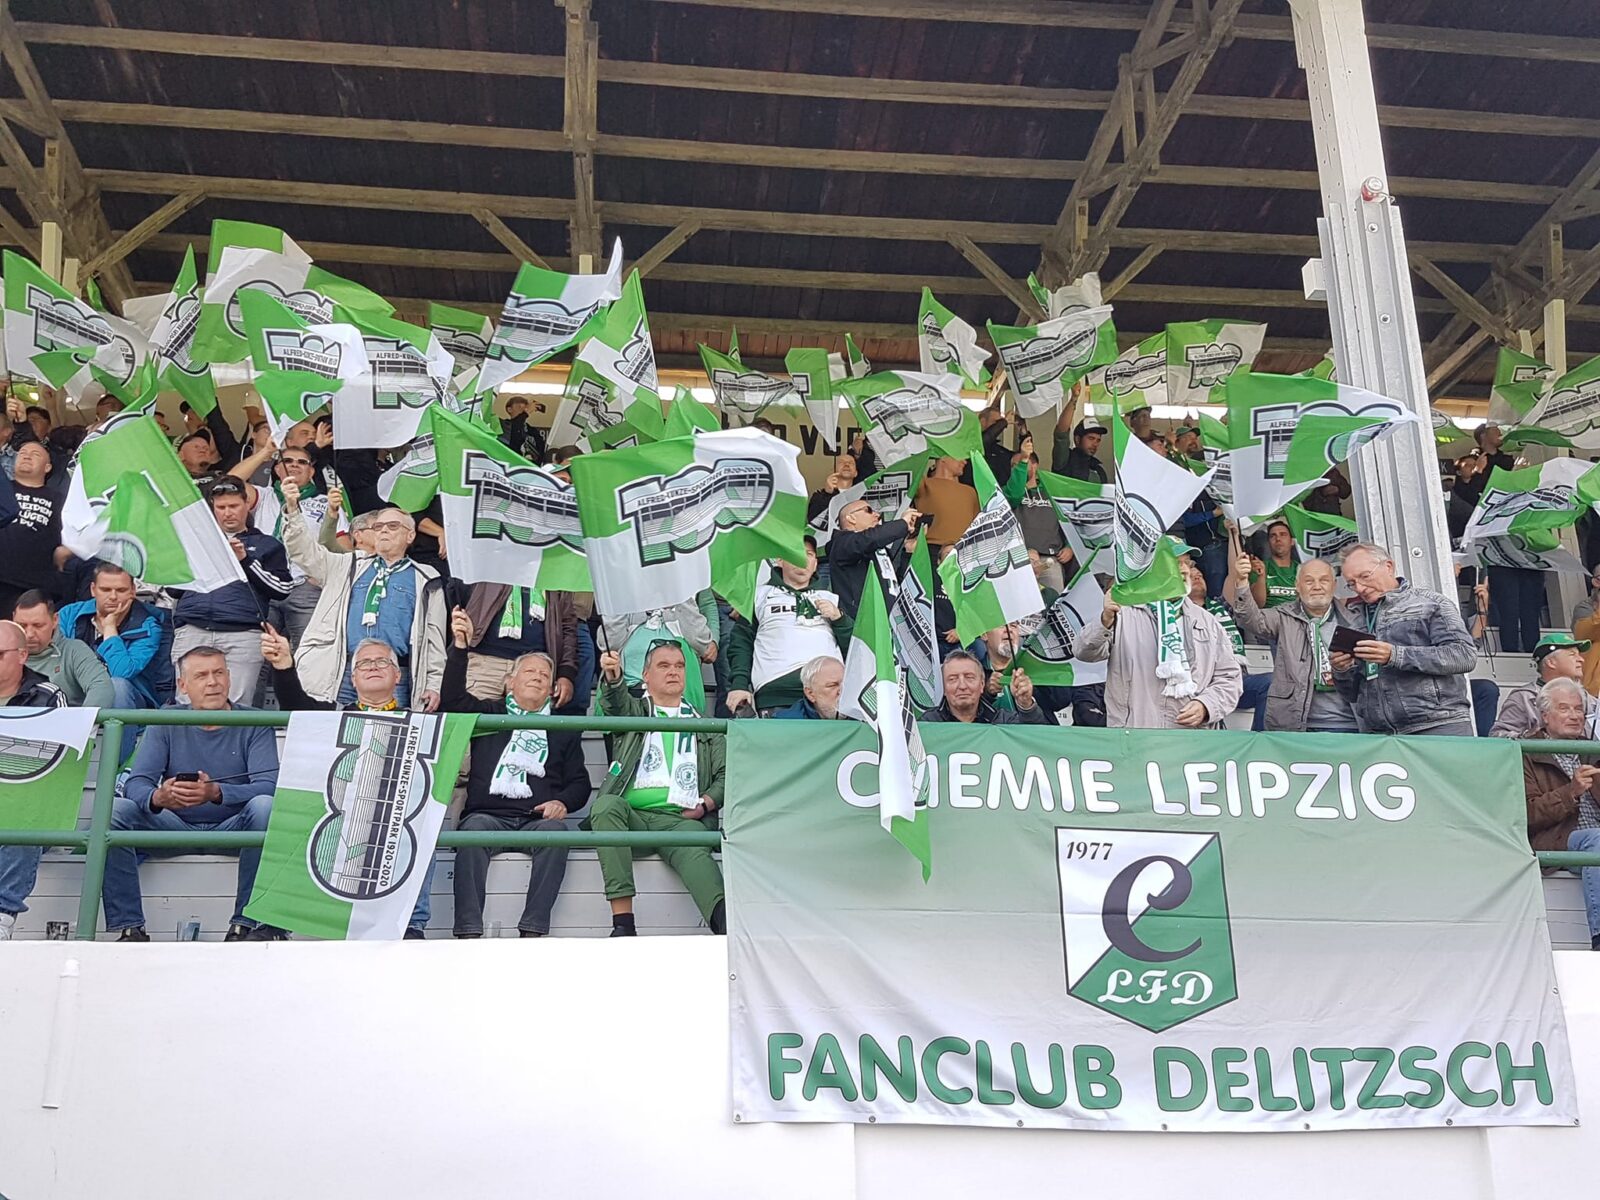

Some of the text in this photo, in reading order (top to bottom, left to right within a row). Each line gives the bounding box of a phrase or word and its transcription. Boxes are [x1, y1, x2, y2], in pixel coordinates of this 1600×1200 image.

[379, 724, 420, 888] ALFRED-KUNZE-SPORTPARK 1920-2020
[1145, 759, 1417, 822] LEIPZIG
[1066, 841, 1113, 861] 1977
[766, 1033, 1552, 1110] FANCLUB DELITZSCH
